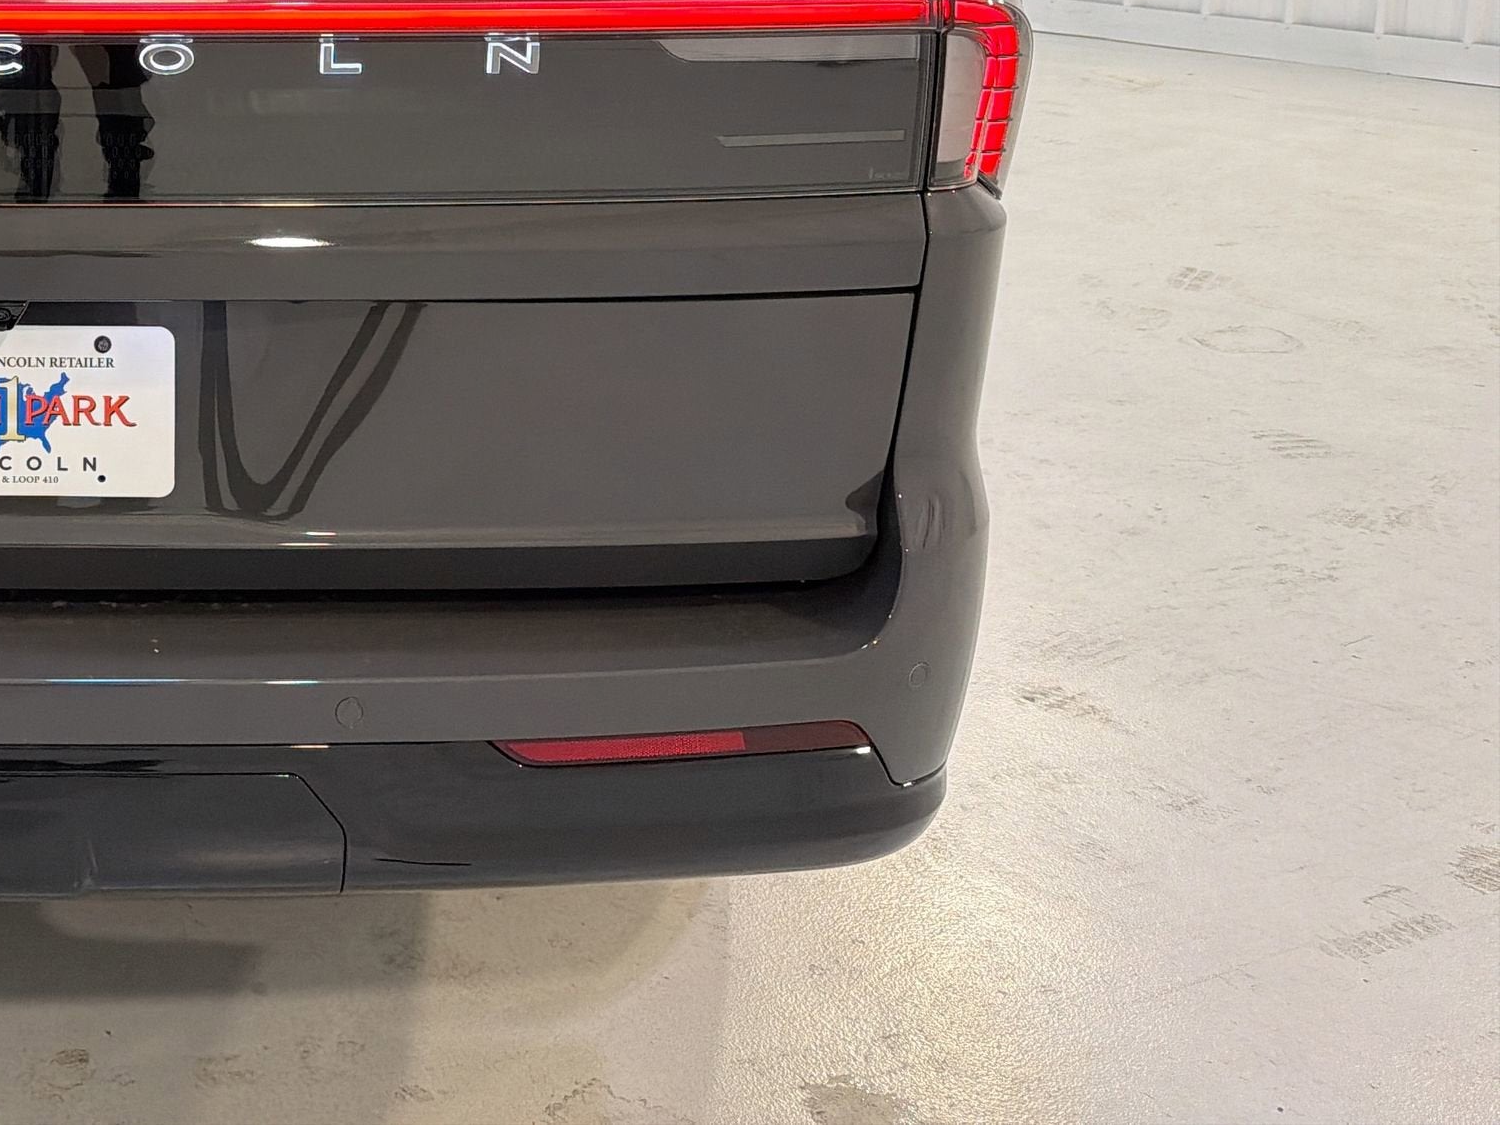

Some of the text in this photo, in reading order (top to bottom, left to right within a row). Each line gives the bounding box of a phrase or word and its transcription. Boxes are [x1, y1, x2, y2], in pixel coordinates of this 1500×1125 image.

[49, 357, 115, 368] RETAILER
[24, 395, 138, 427] PARK
[1, 475, 10, 484] &
[12, 475, 41, 484] LOOP
[42, 475, 59, 484] 410
